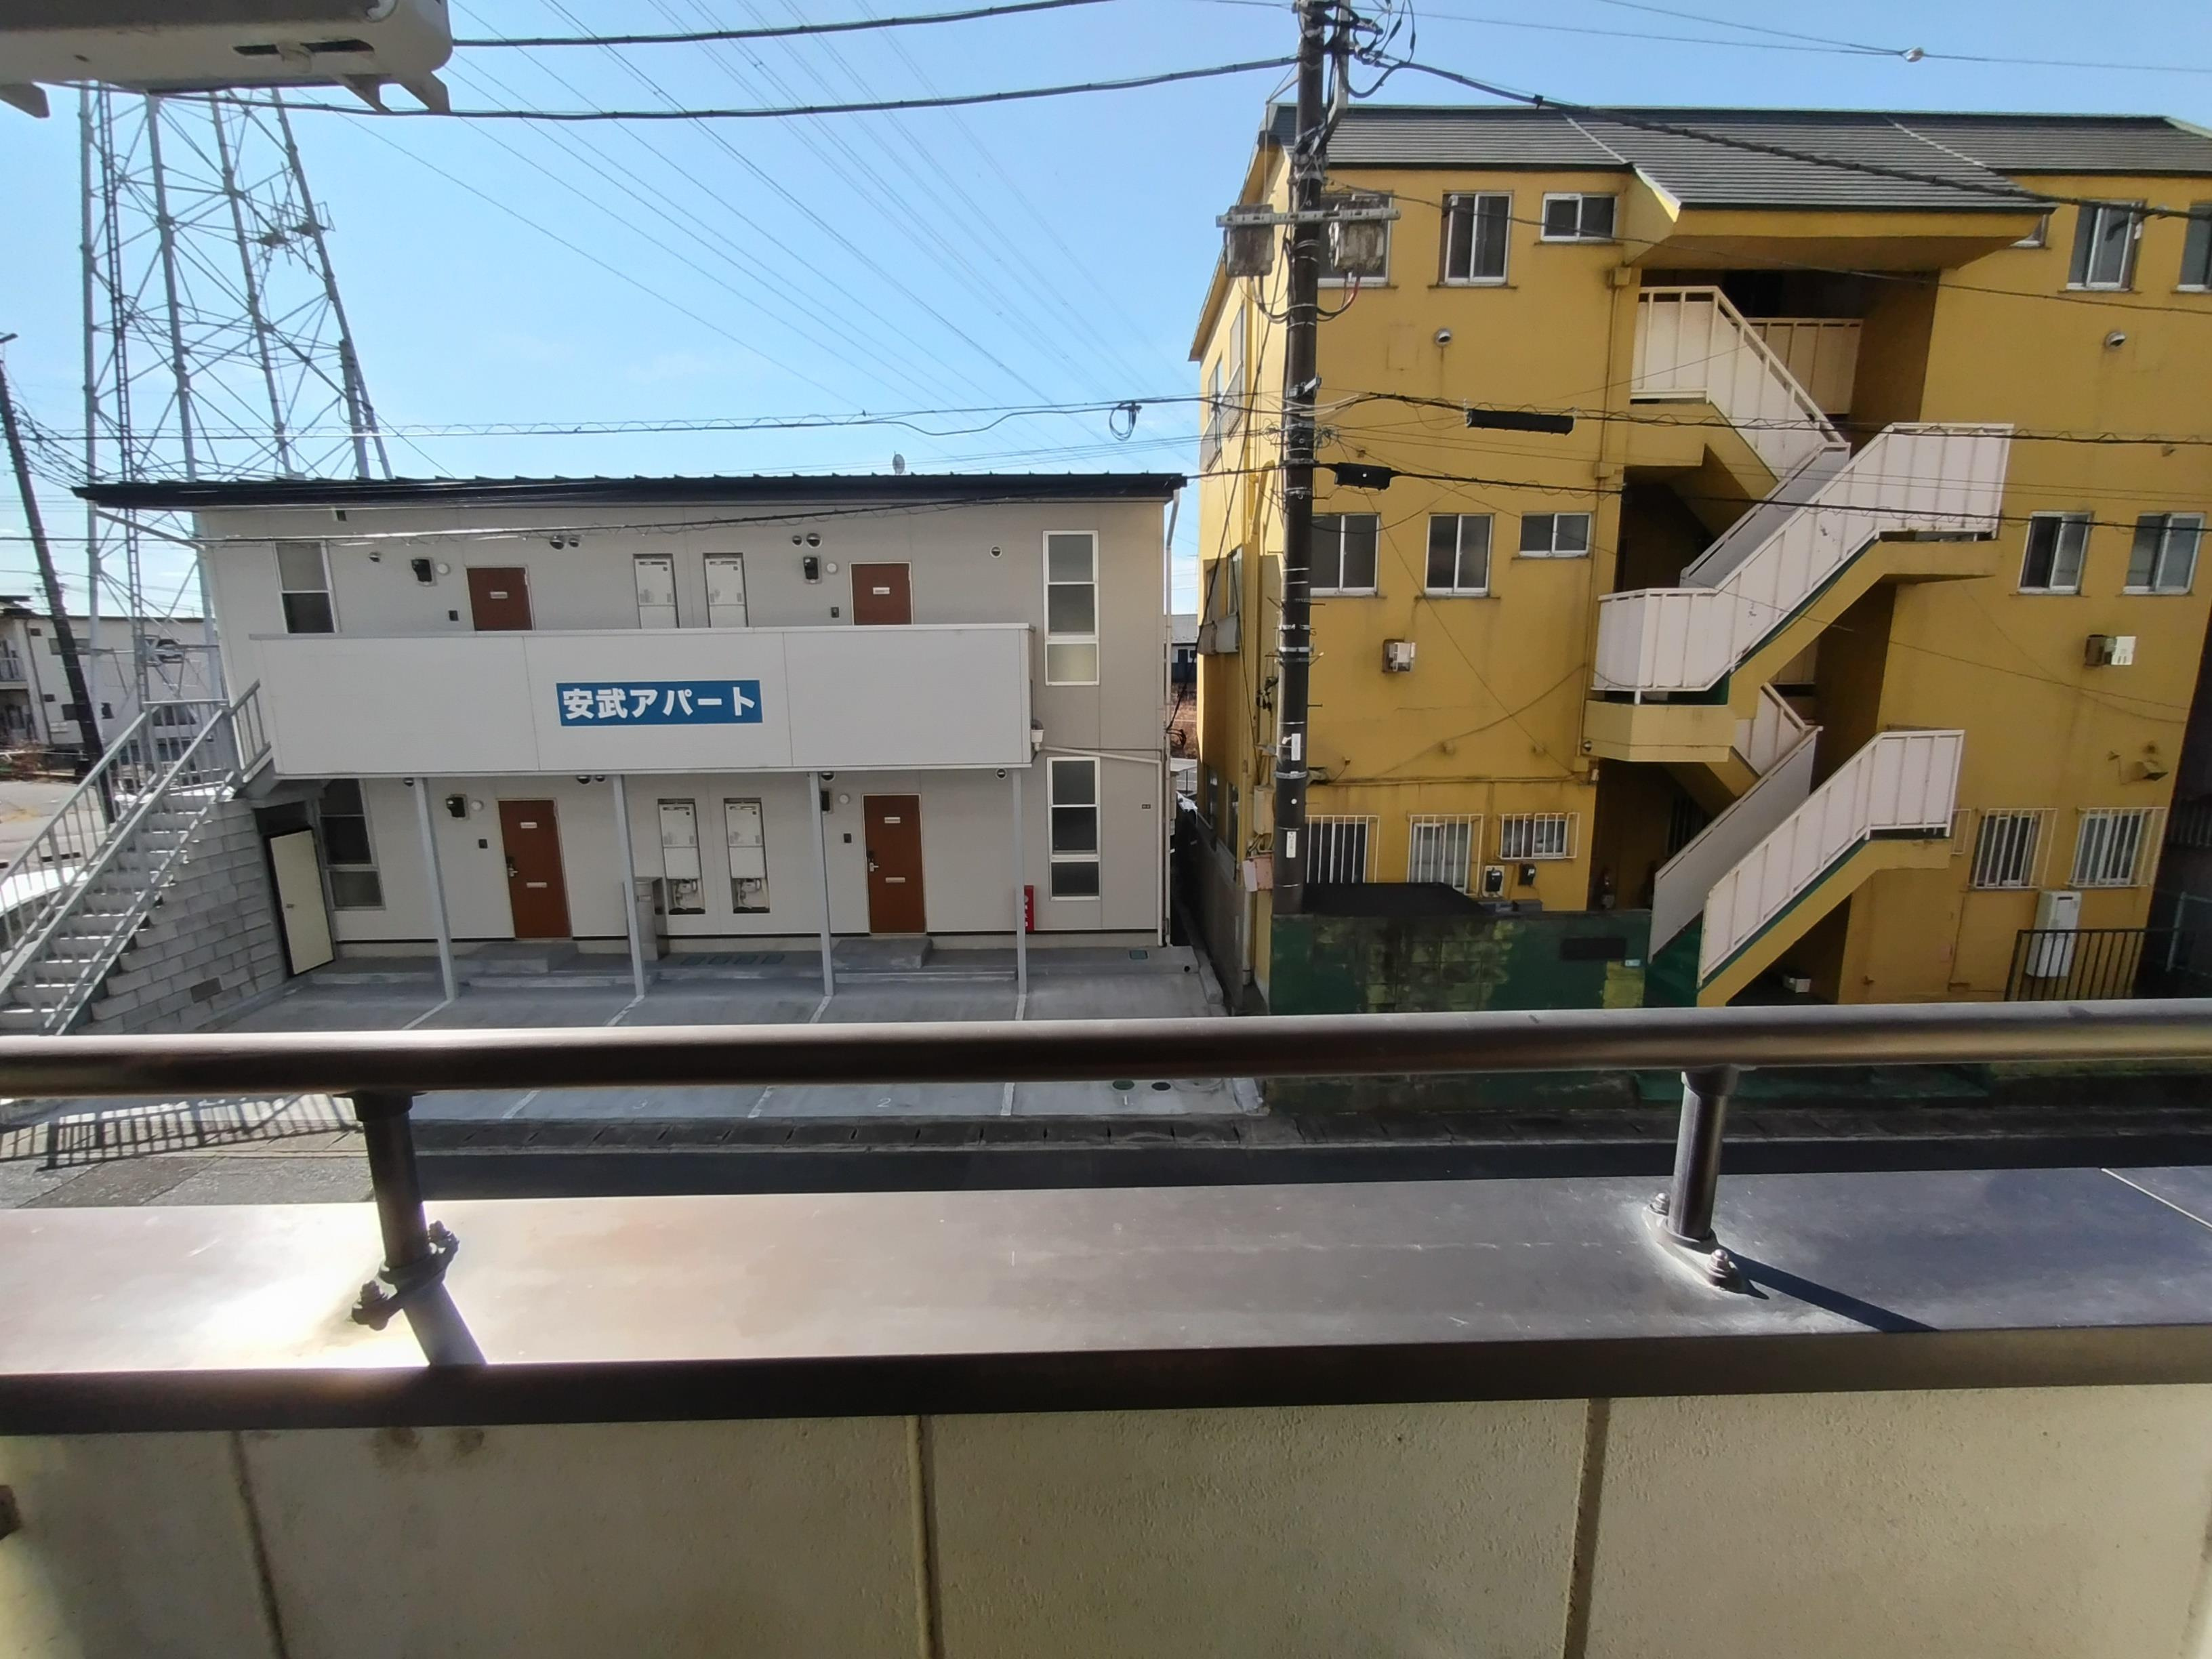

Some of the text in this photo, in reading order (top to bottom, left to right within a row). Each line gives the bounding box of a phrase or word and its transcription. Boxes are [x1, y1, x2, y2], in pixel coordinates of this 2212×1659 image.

[562, 687, 755, 720] 安武アパート
[876, 1097, 891, 1108] 2
